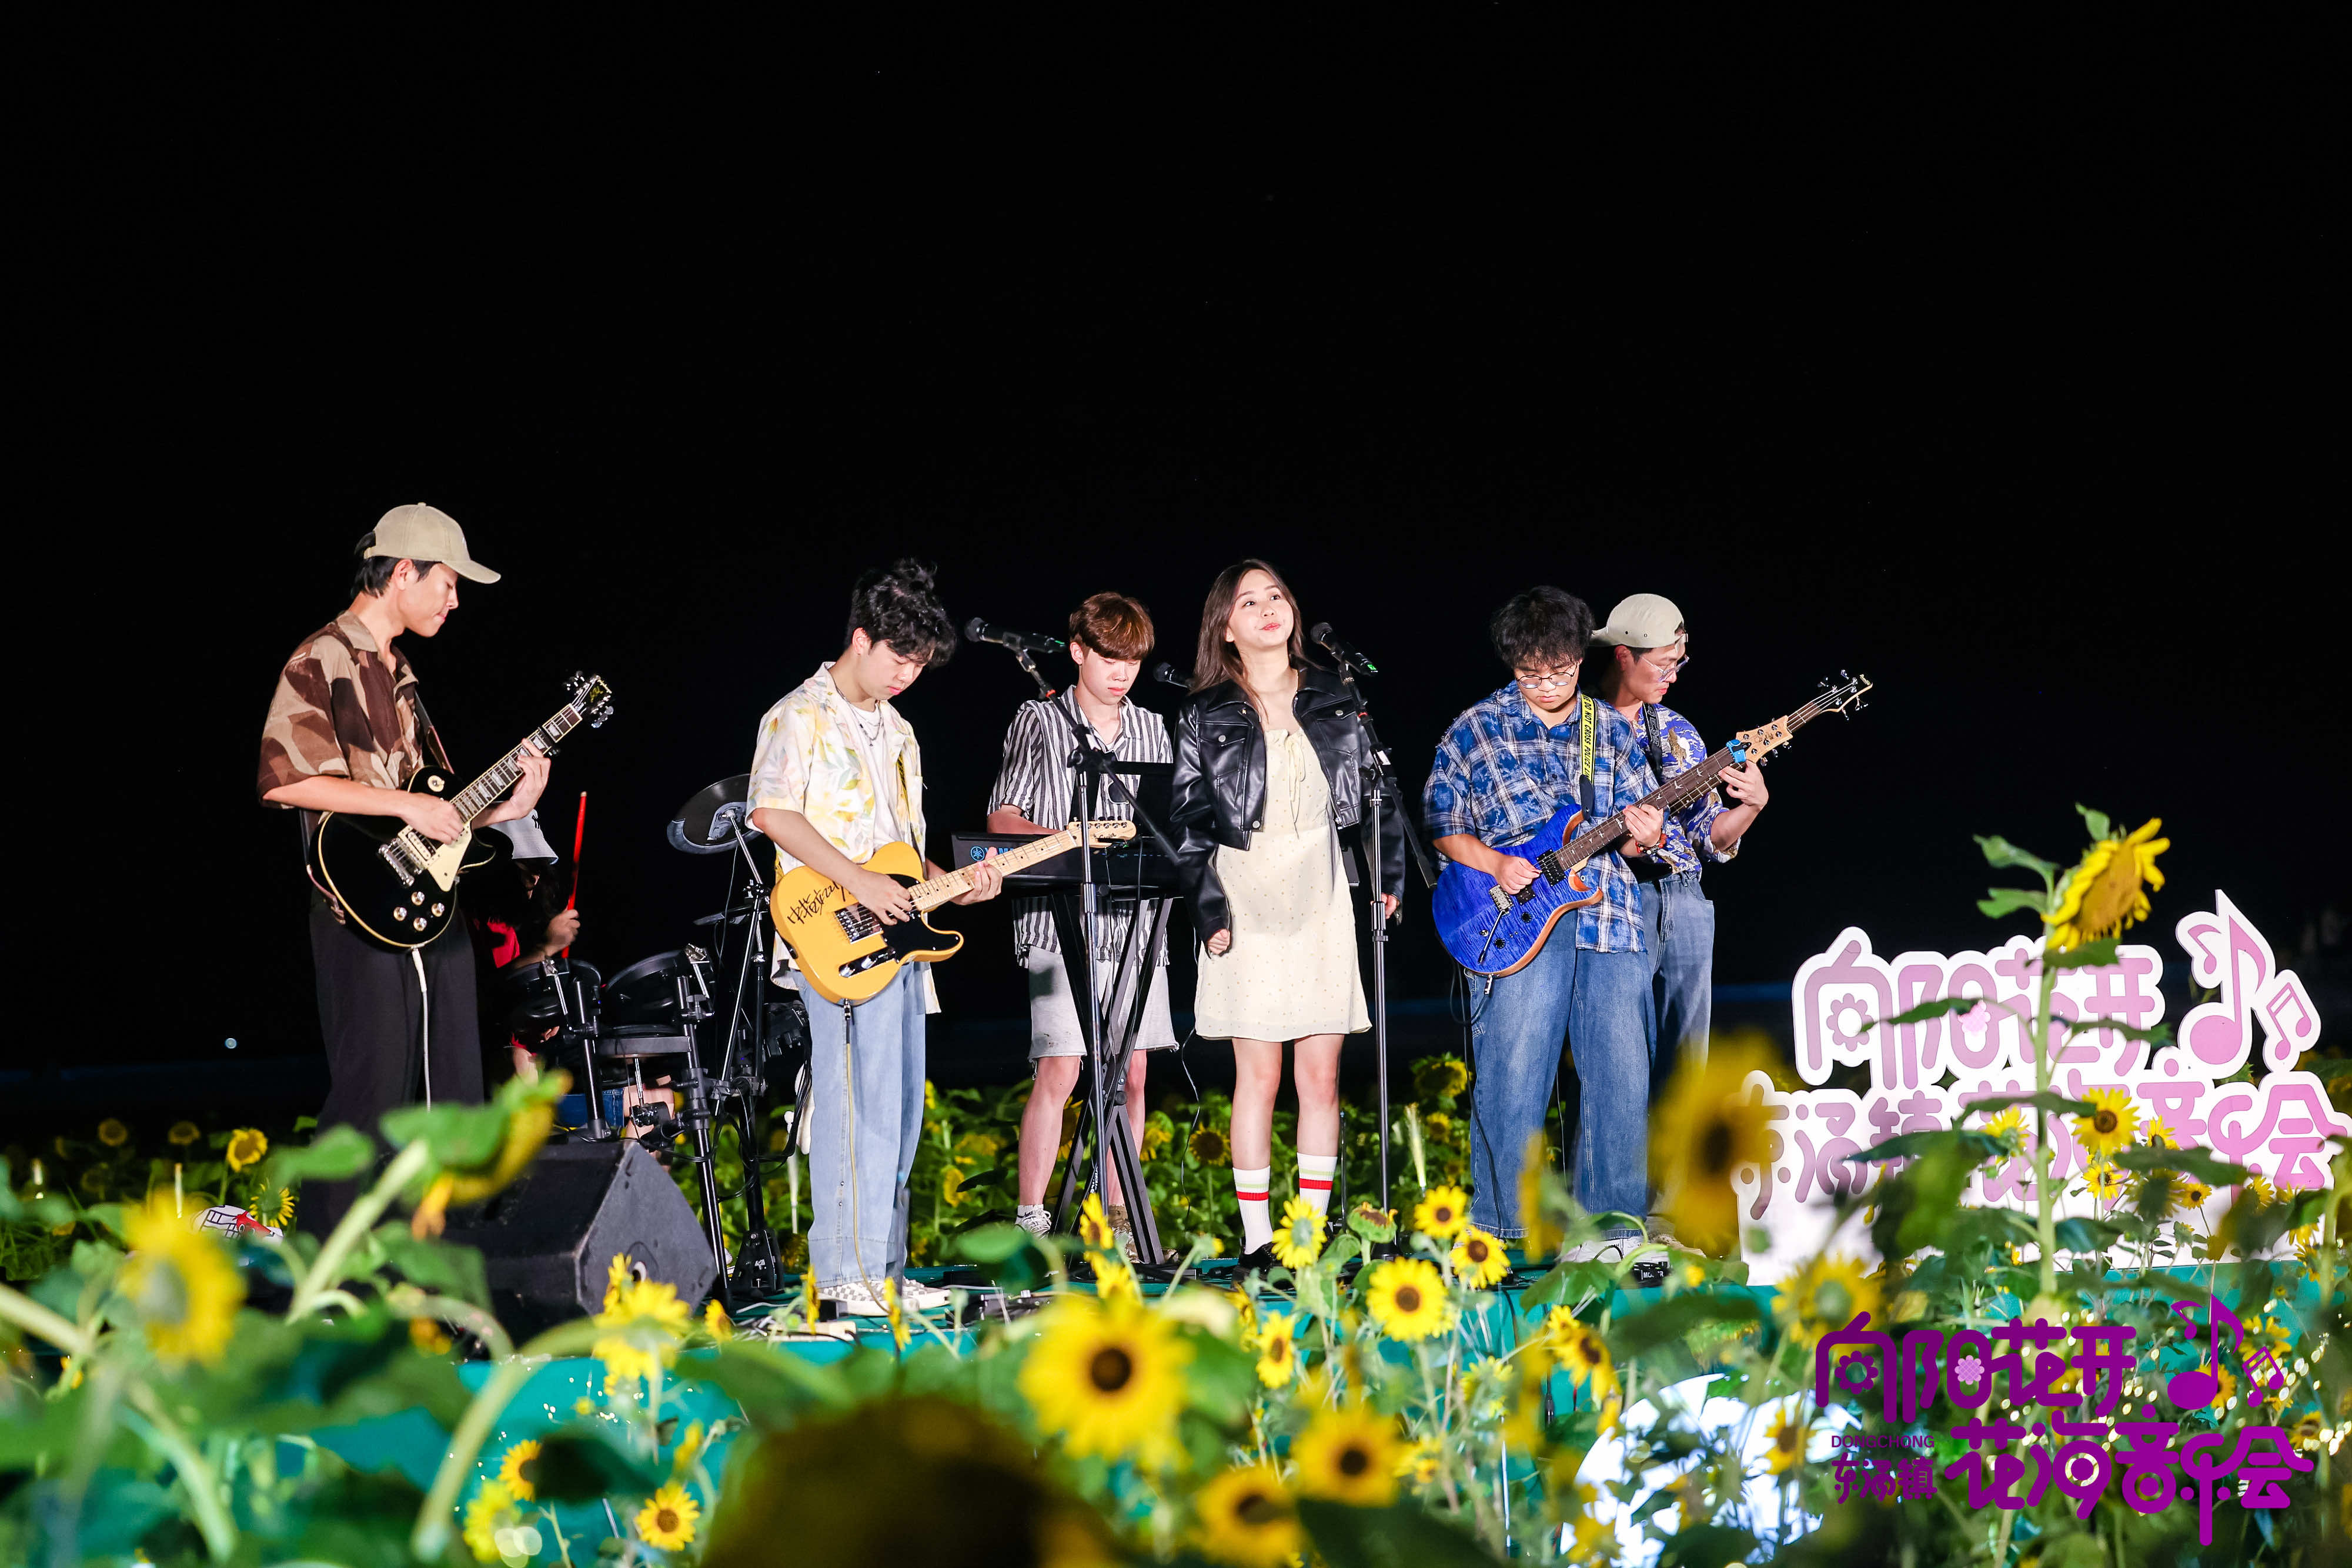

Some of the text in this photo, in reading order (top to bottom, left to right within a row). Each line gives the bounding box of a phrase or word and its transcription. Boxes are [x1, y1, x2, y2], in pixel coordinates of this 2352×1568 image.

[1584, 701, 1592, 710] DO
[1805, 940, 2154, 1089] 向阳花开
